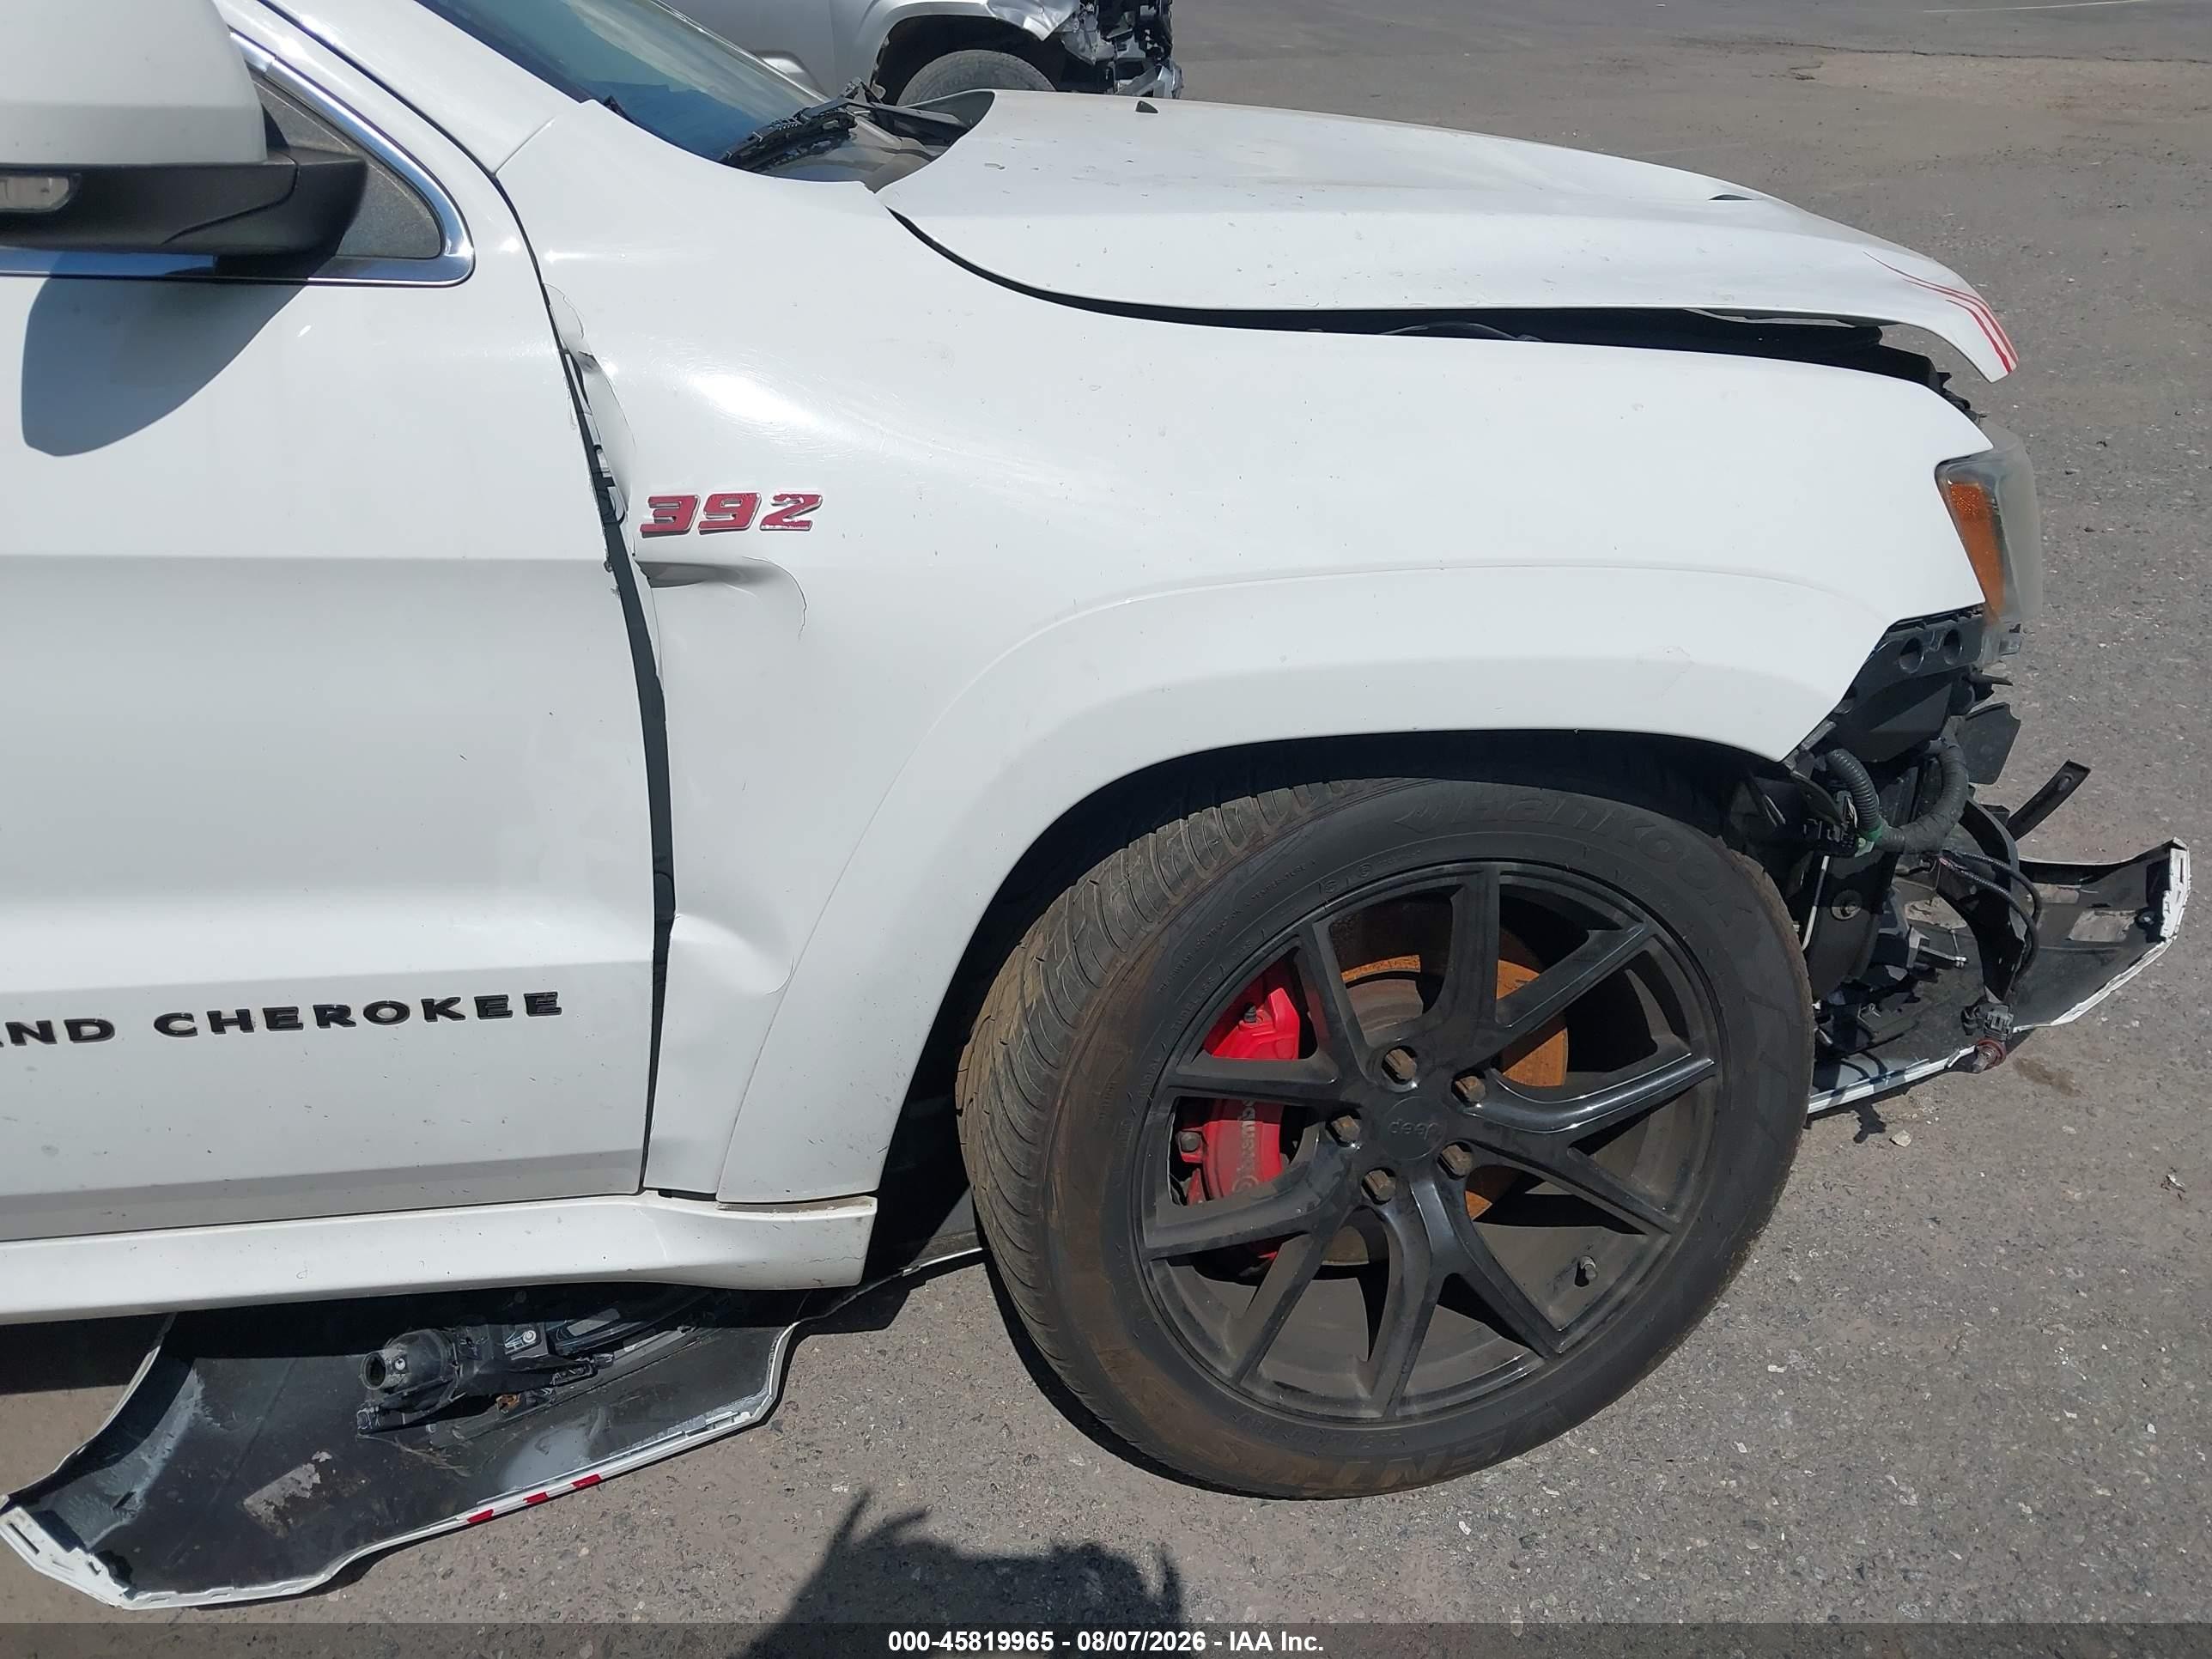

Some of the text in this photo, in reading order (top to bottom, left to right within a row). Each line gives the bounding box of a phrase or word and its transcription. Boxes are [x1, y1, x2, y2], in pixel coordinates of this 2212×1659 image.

[639, 491, 823, 538] 392
[0, 991, 562, 1046] ND CHEROKEE
